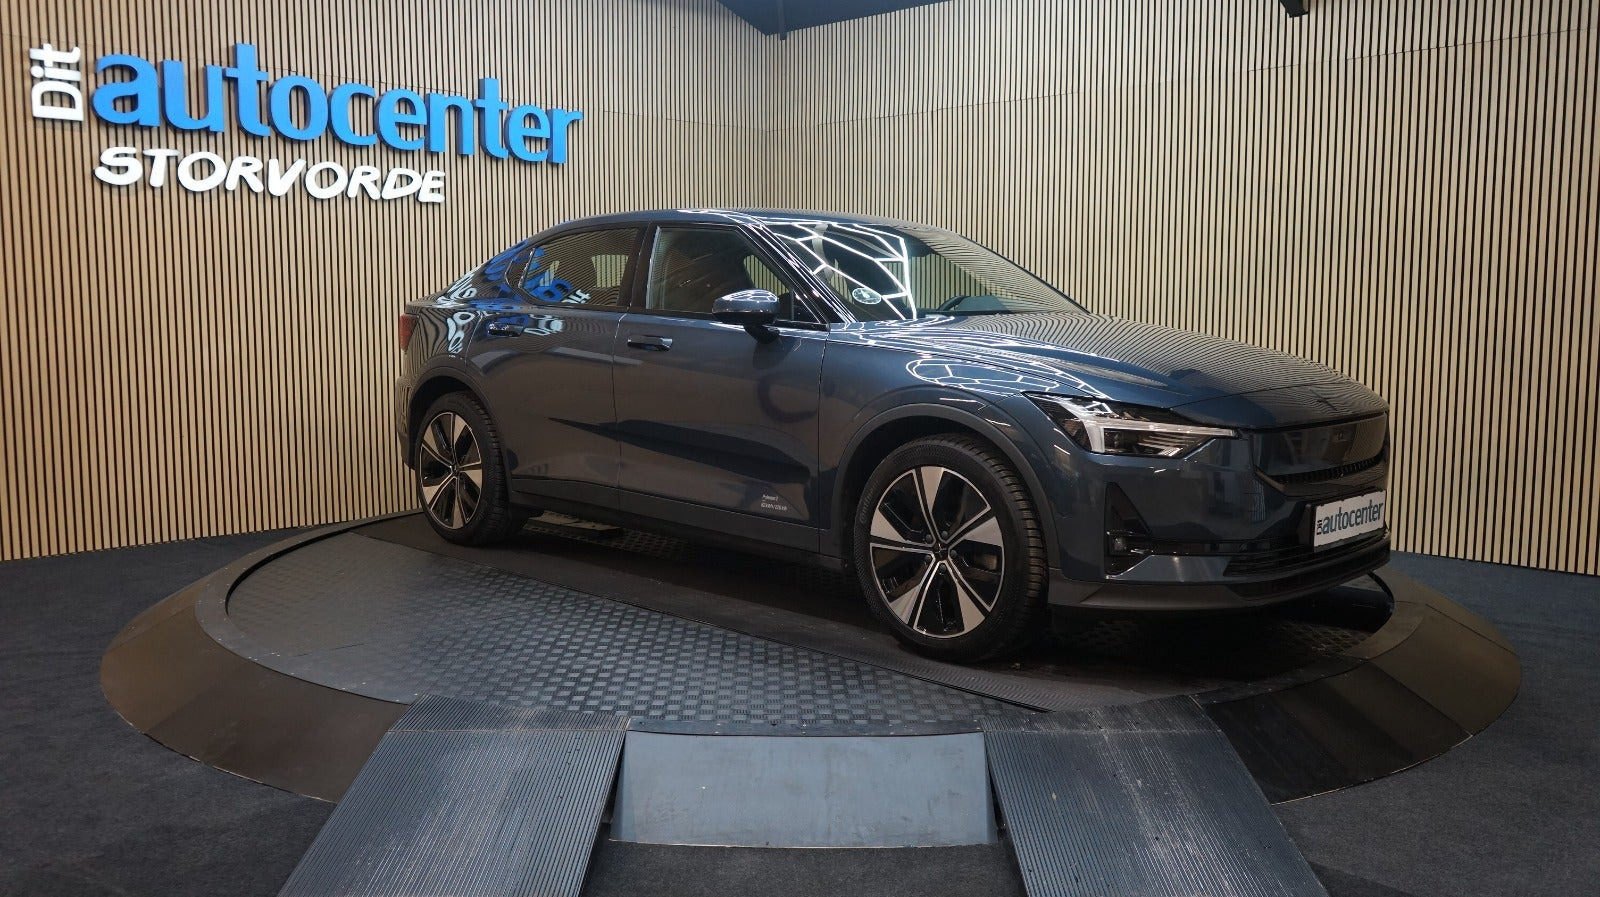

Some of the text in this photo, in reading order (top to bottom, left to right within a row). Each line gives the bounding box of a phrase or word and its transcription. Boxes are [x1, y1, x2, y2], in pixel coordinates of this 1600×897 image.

[29, 42, 583, 164] Dit autocenter
[94, 146, 446, 203] STORVORDE
[1322, 499, 1384, 535] autocenter
